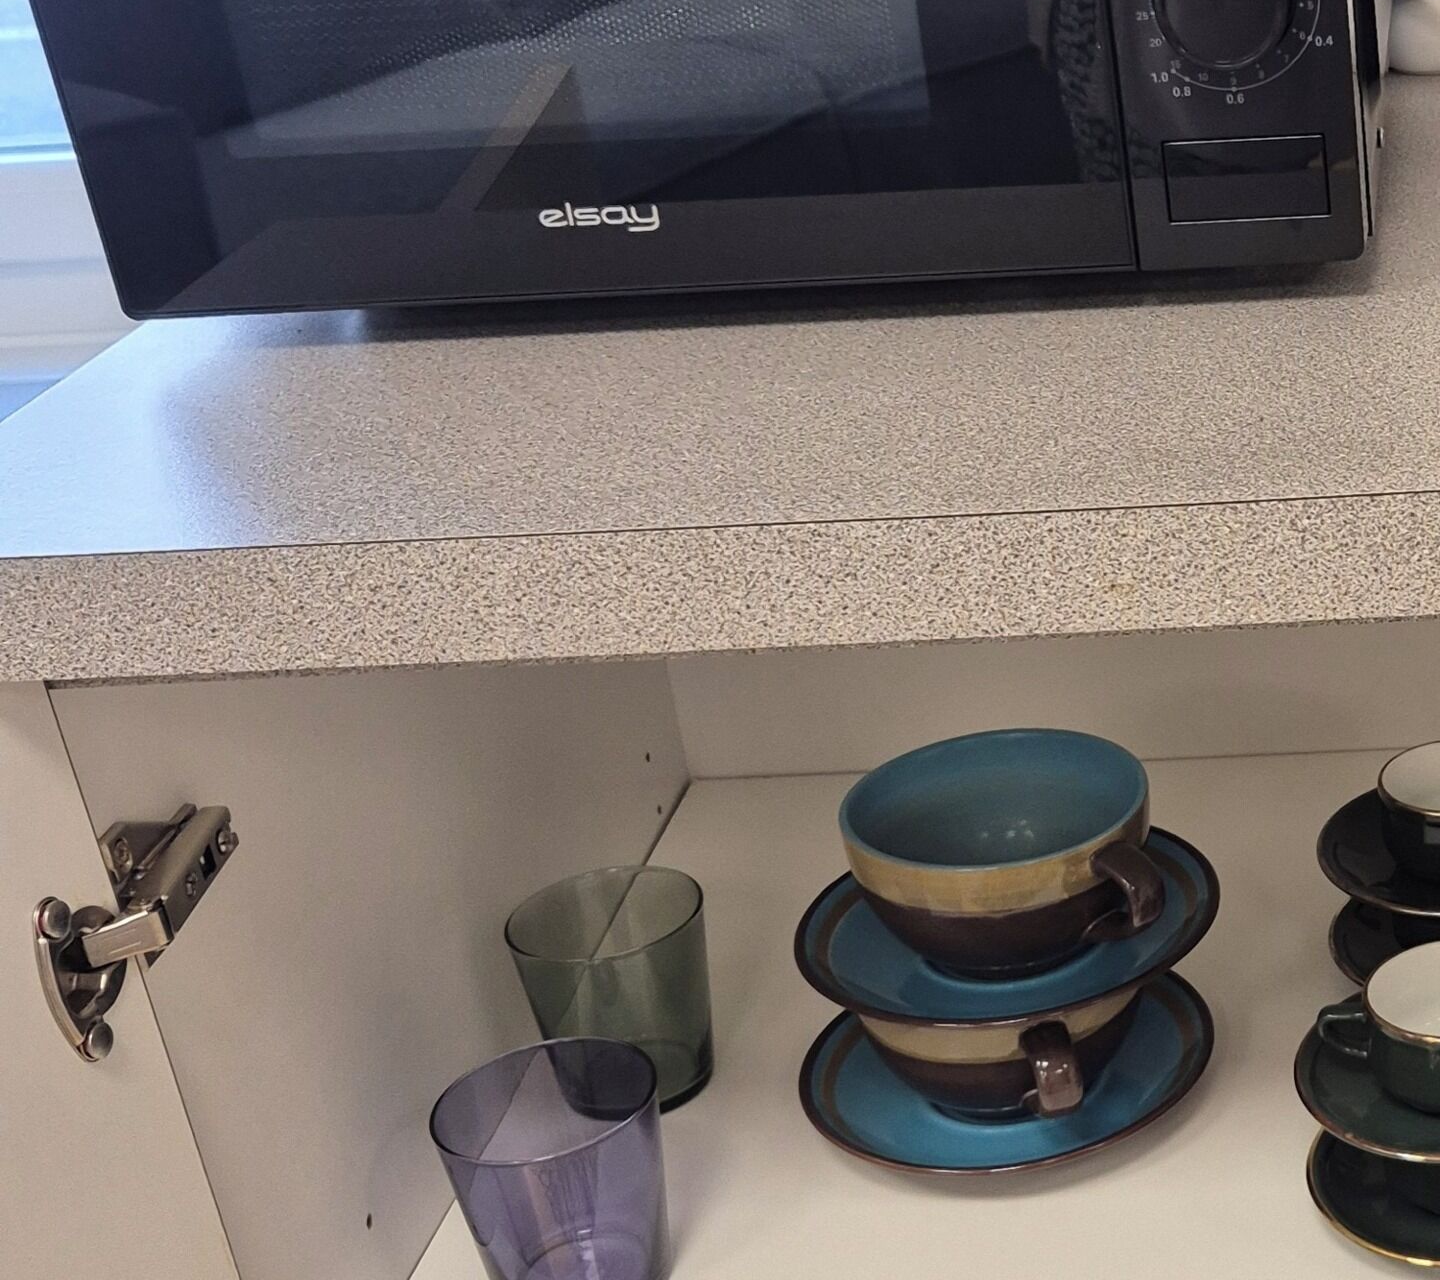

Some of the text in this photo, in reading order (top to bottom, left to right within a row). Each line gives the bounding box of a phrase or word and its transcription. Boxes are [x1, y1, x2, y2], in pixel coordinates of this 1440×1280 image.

[1136, 11, 1150, 22] 25
[1149, 38, 1163, 48] 20
[1315, 35, 1334, 48] 0.4
[1150, 71, 1169, 83] 1.0
[1172, 86, 1192, 98] 0.8
[1226, 93, 1245, 105] 0.6
[538, 201, 661, 233] elsay
